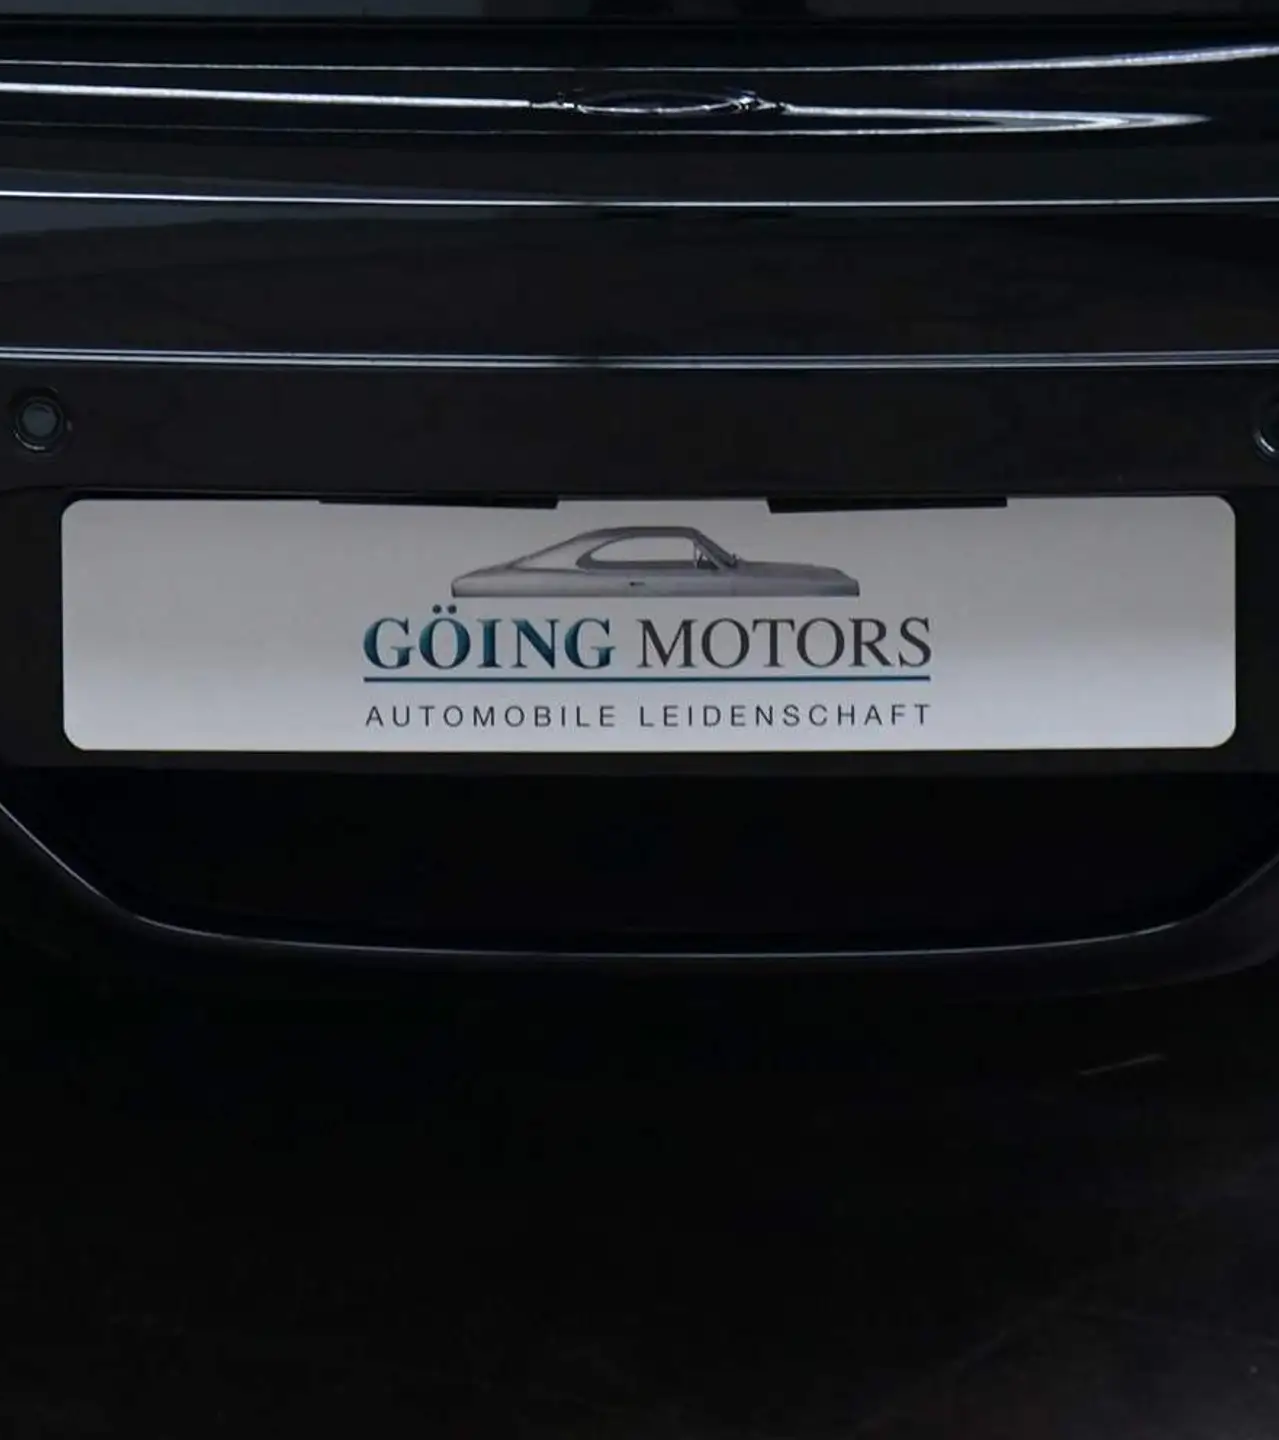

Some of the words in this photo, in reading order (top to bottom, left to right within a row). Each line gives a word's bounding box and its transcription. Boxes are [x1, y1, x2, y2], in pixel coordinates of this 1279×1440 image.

[362, 603, 617, 670] GÖING
[636, 616, 932, 669] MOTORS
[365, 704, 616, 728] AUTOMOBILE
[639, 703, 931, 728] LEIDENSCHAFT
